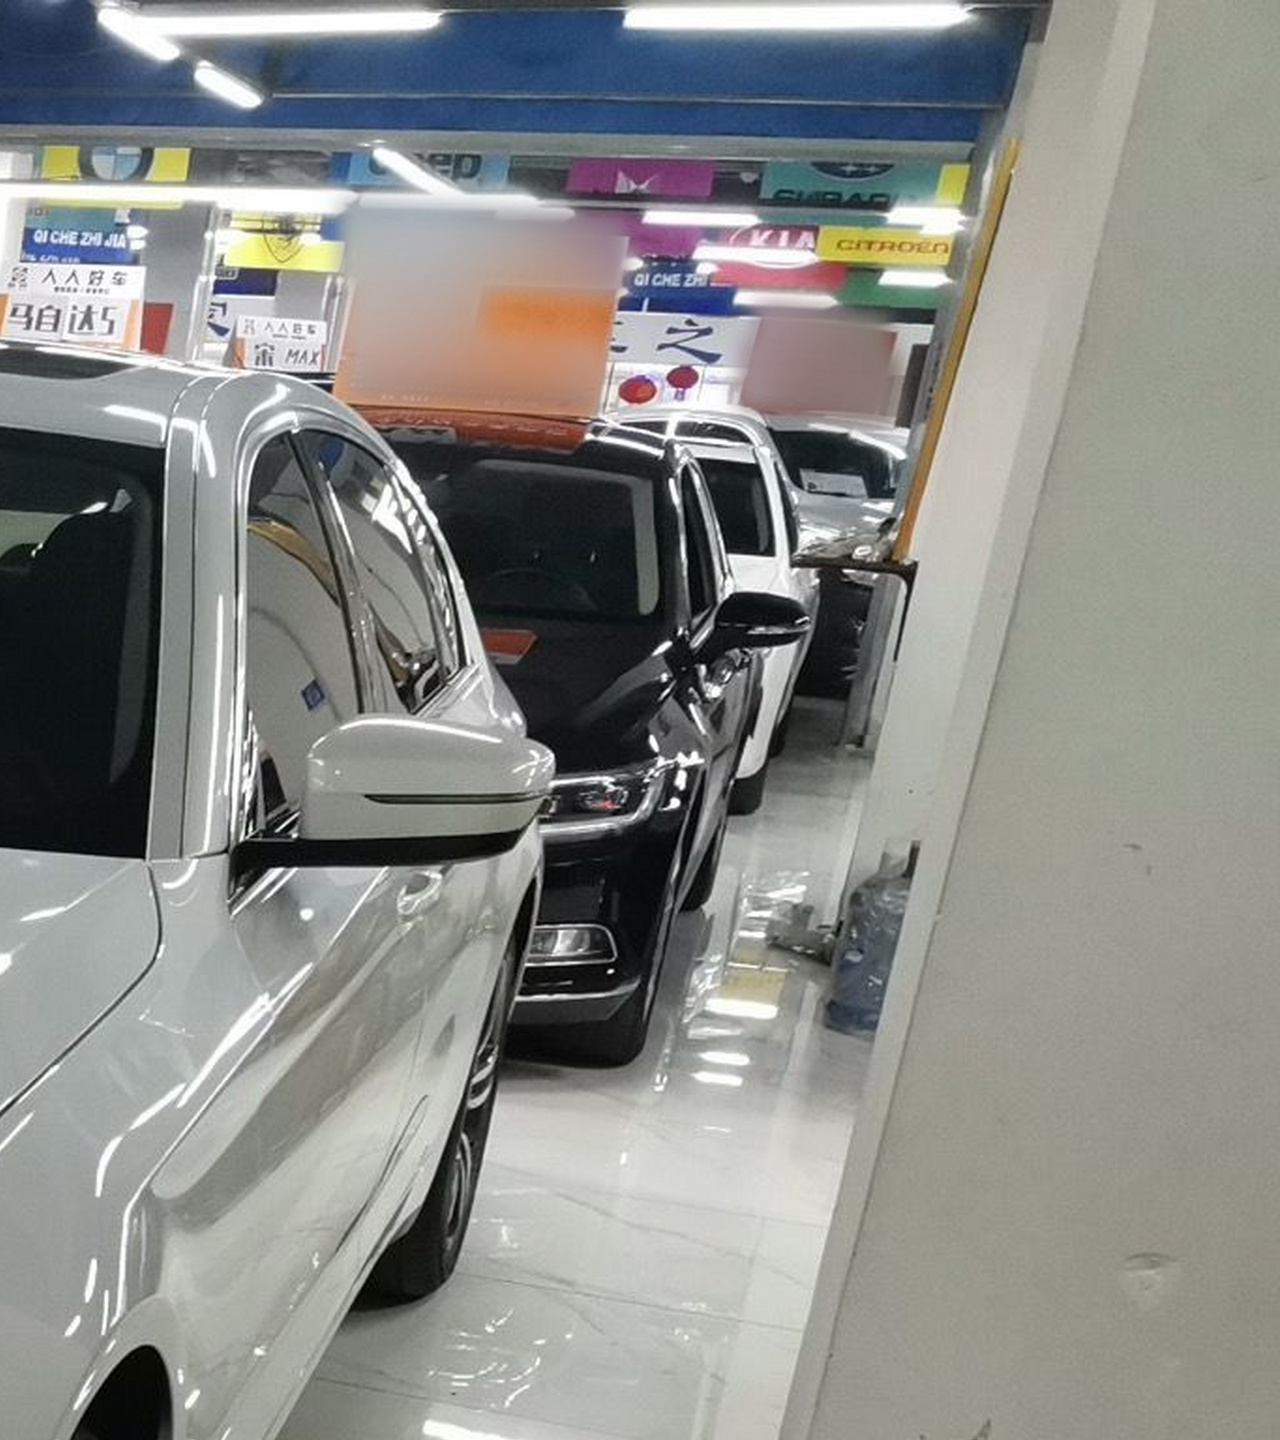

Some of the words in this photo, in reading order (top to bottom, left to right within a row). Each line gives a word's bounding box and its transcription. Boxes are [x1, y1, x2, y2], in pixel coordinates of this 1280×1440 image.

[34, 229, 48, 243] QI
[49, 231, 79, 246] CHE
[79, 232, 102, 248] ZHI
[104, 233, 127, 249] JIA
[748, 228, 816, 249] KIA
[634, 273, 649, 286] QI
[651, 274, 681, 288] CHE
[7, 303, 119, 336] 马自达5
[285, 348, 320, 366] MAX
